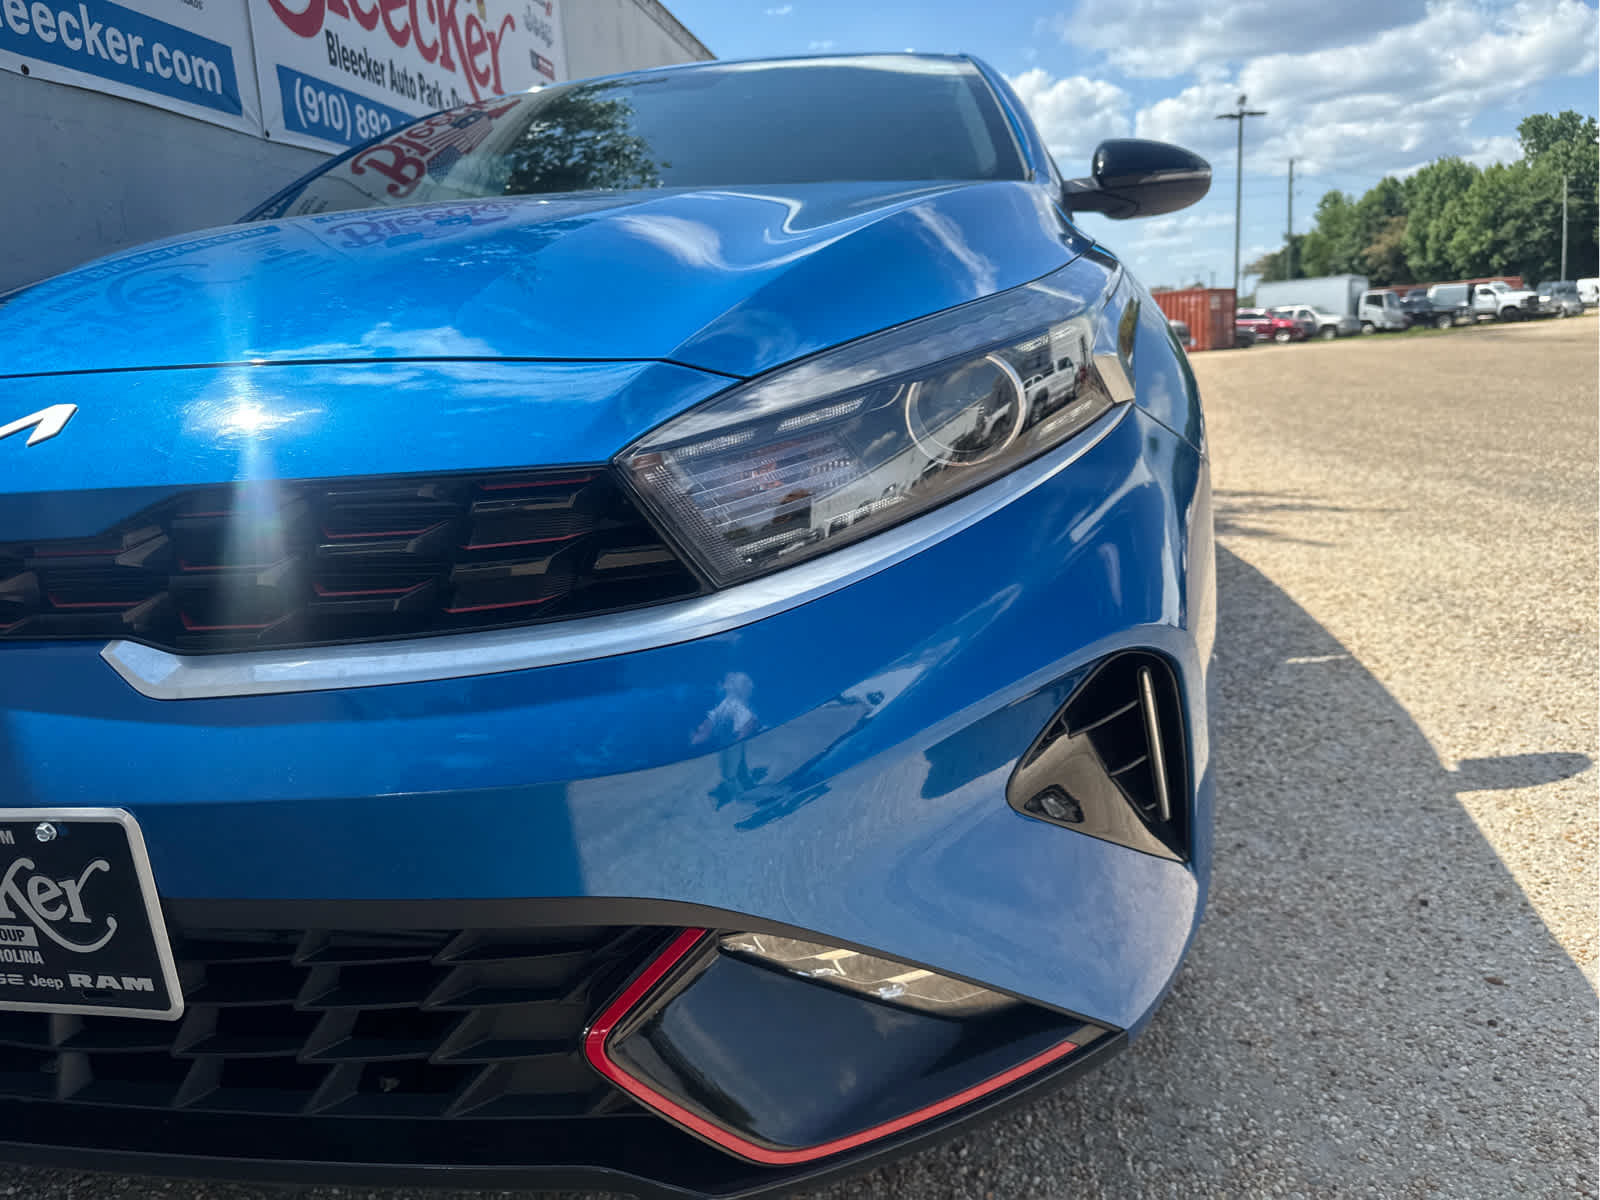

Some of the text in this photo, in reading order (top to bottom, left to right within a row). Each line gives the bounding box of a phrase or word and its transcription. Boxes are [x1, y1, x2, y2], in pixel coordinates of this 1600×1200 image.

[0, 0, 223, 95] eecker.com
[324, 28, 386, 88] Bleecker
[389, 59, 416, 100] Auto
[417, 72, 443, 109] Park
[294, 77, 351, 141] (910)
[0, 928, 25, 942] OUP
[29, 974, 64, 990] Jeep
[68, 973, 155, 991] RAM
